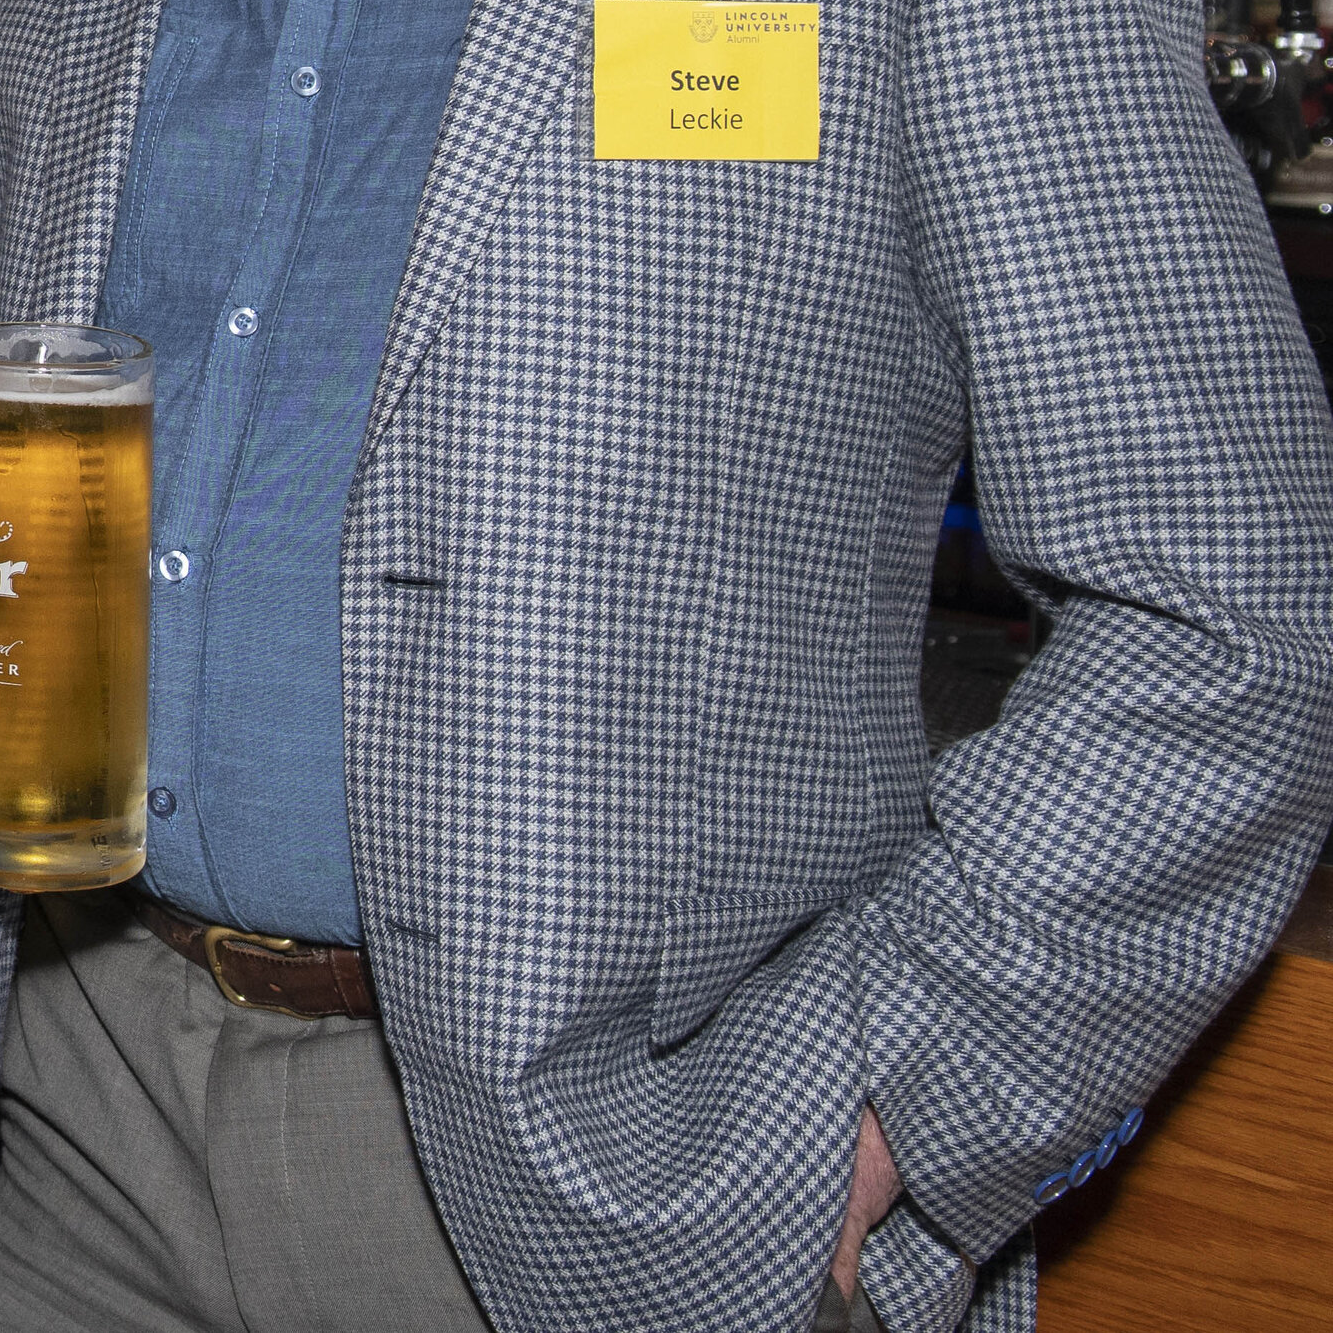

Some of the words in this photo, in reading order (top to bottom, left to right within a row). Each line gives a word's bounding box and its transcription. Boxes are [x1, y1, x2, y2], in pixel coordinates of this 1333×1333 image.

[725, 12, 788, 21] LINCOLN
[725, 23, 816, 33] UNIVERSITY
[726, 34, 760, 44] Alumni
[670, 69, 740, 92] Steve
[670, 107, 743, 130] Leckie
